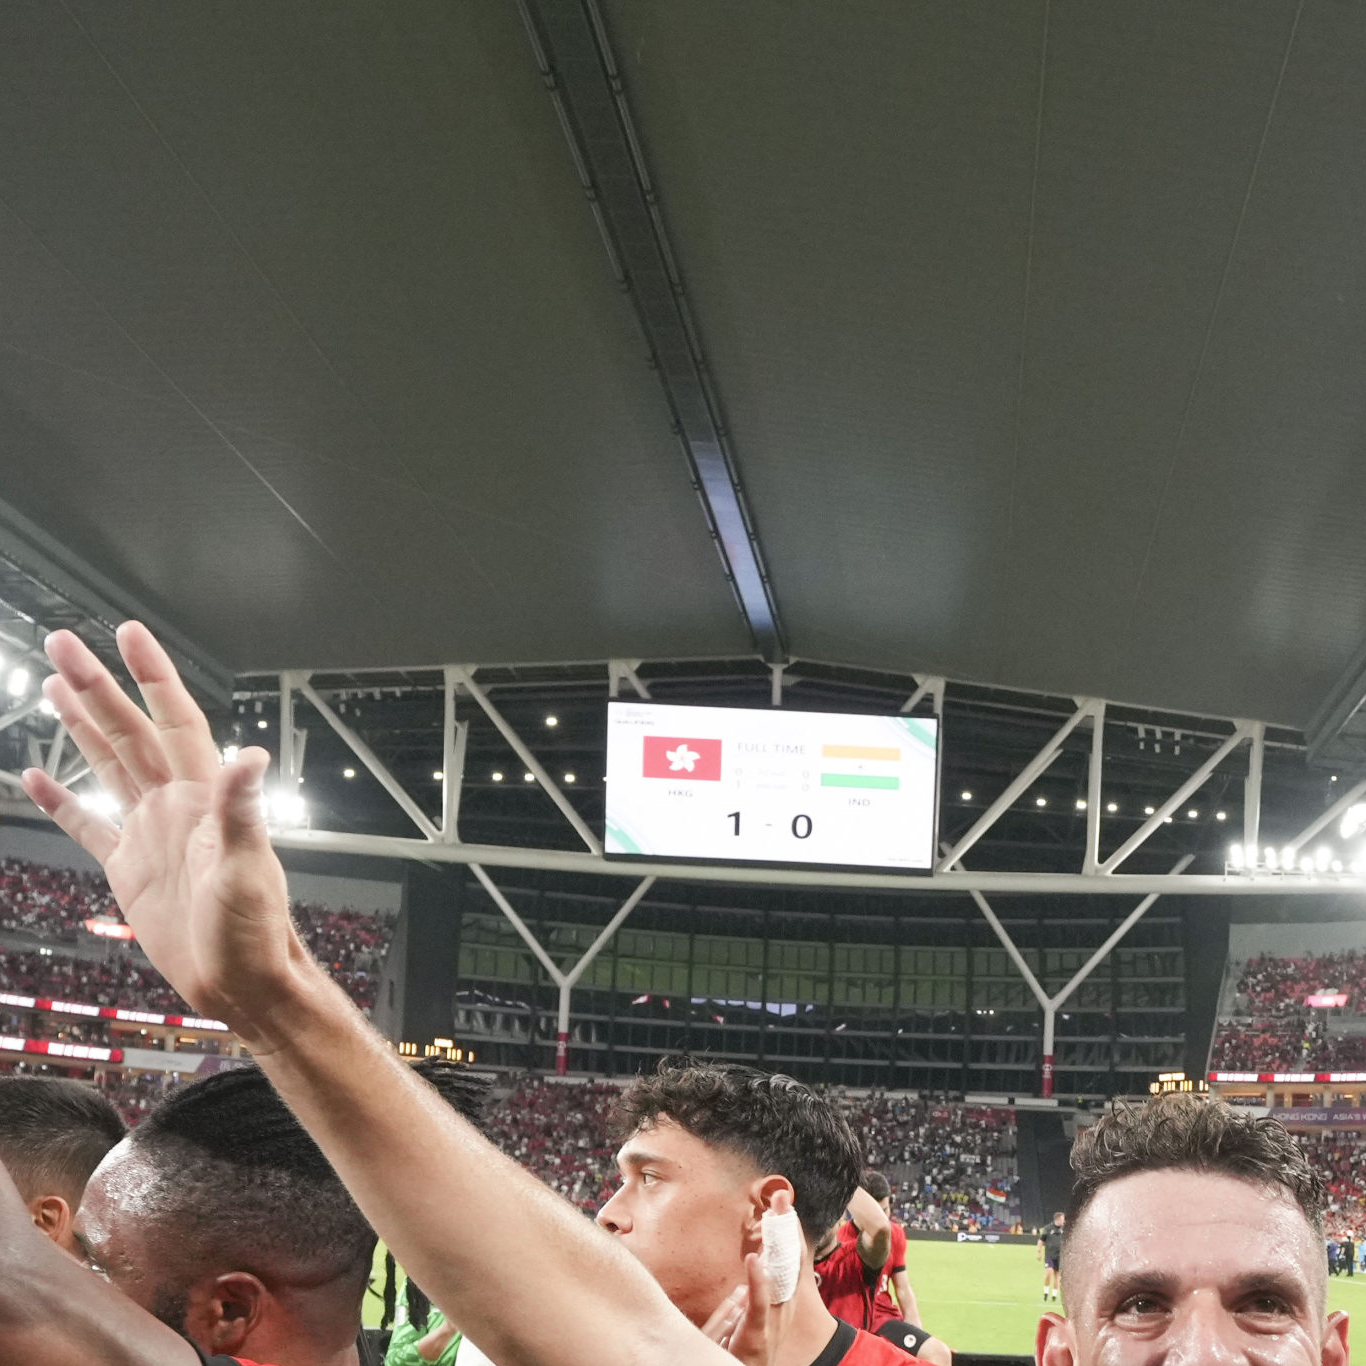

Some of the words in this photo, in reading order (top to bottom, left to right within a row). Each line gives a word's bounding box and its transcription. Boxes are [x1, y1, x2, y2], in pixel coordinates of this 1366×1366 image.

[727, 811, 741, 836] 1
[791, 814, 813, 839] 0
[1273, 1113, 1299, 1121] HONG
[1301, 1113, 1327, 1121] KONG
[1332, 1112, 1361, 1121] ASIA'S
